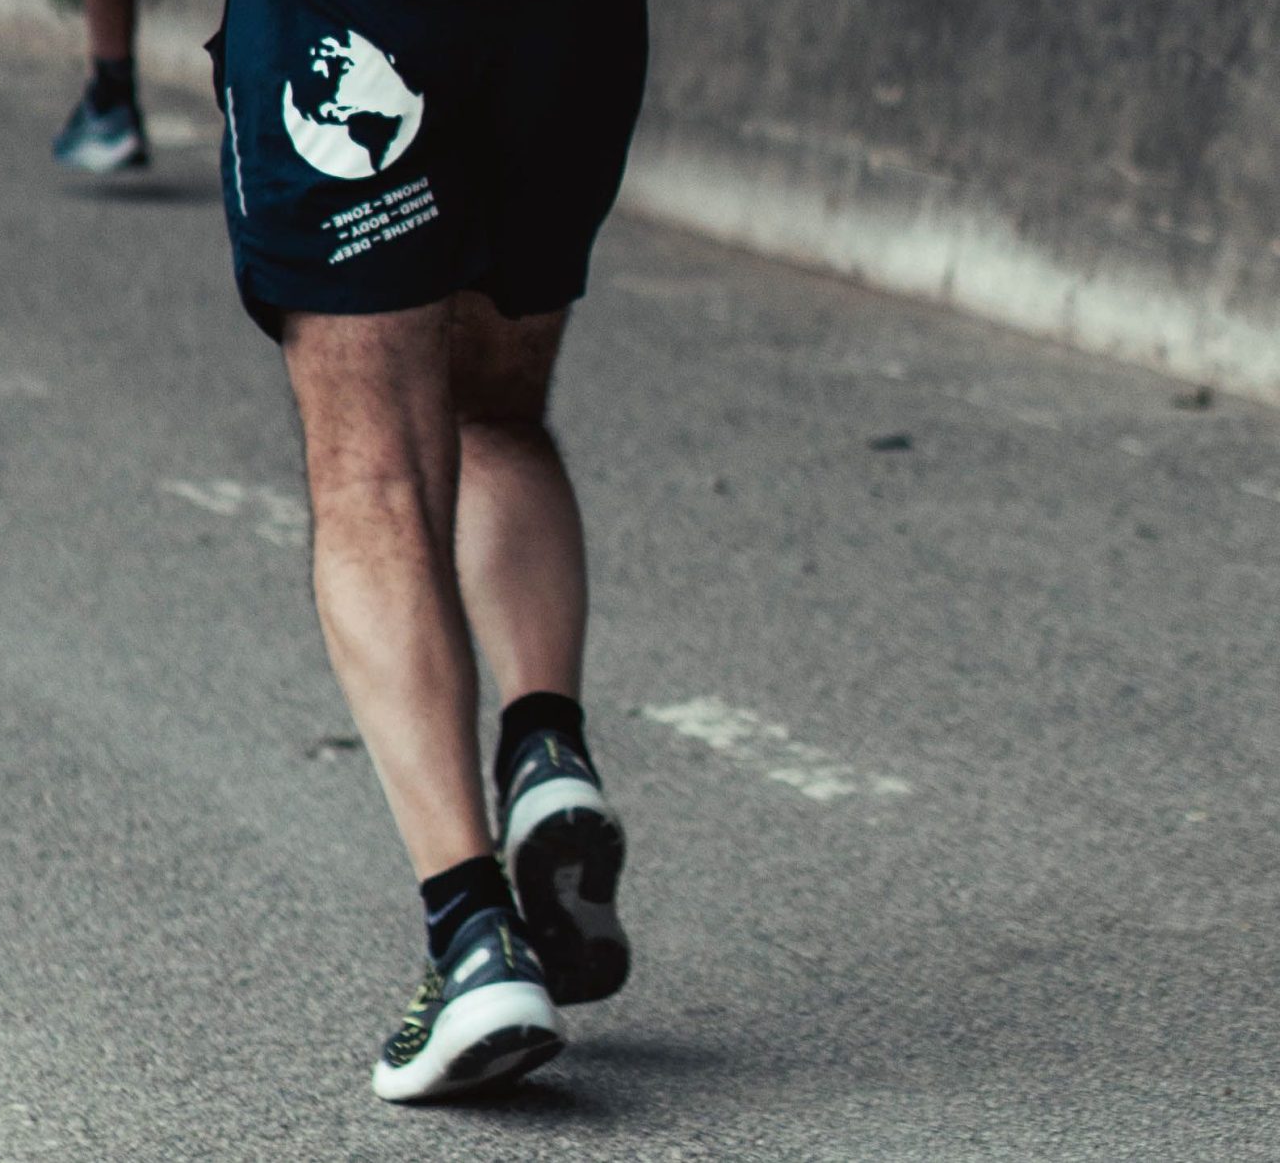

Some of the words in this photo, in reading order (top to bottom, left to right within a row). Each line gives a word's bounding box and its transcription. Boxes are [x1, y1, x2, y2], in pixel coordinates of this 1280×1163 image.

[384, 177, 429, 206] DRONE
[400, 190, 434, 215] MIND
[332, 202, 373, 228] ZONE
[352, 213, 390, 237] BODY
[382, 206, 439, 241] BREATHE
